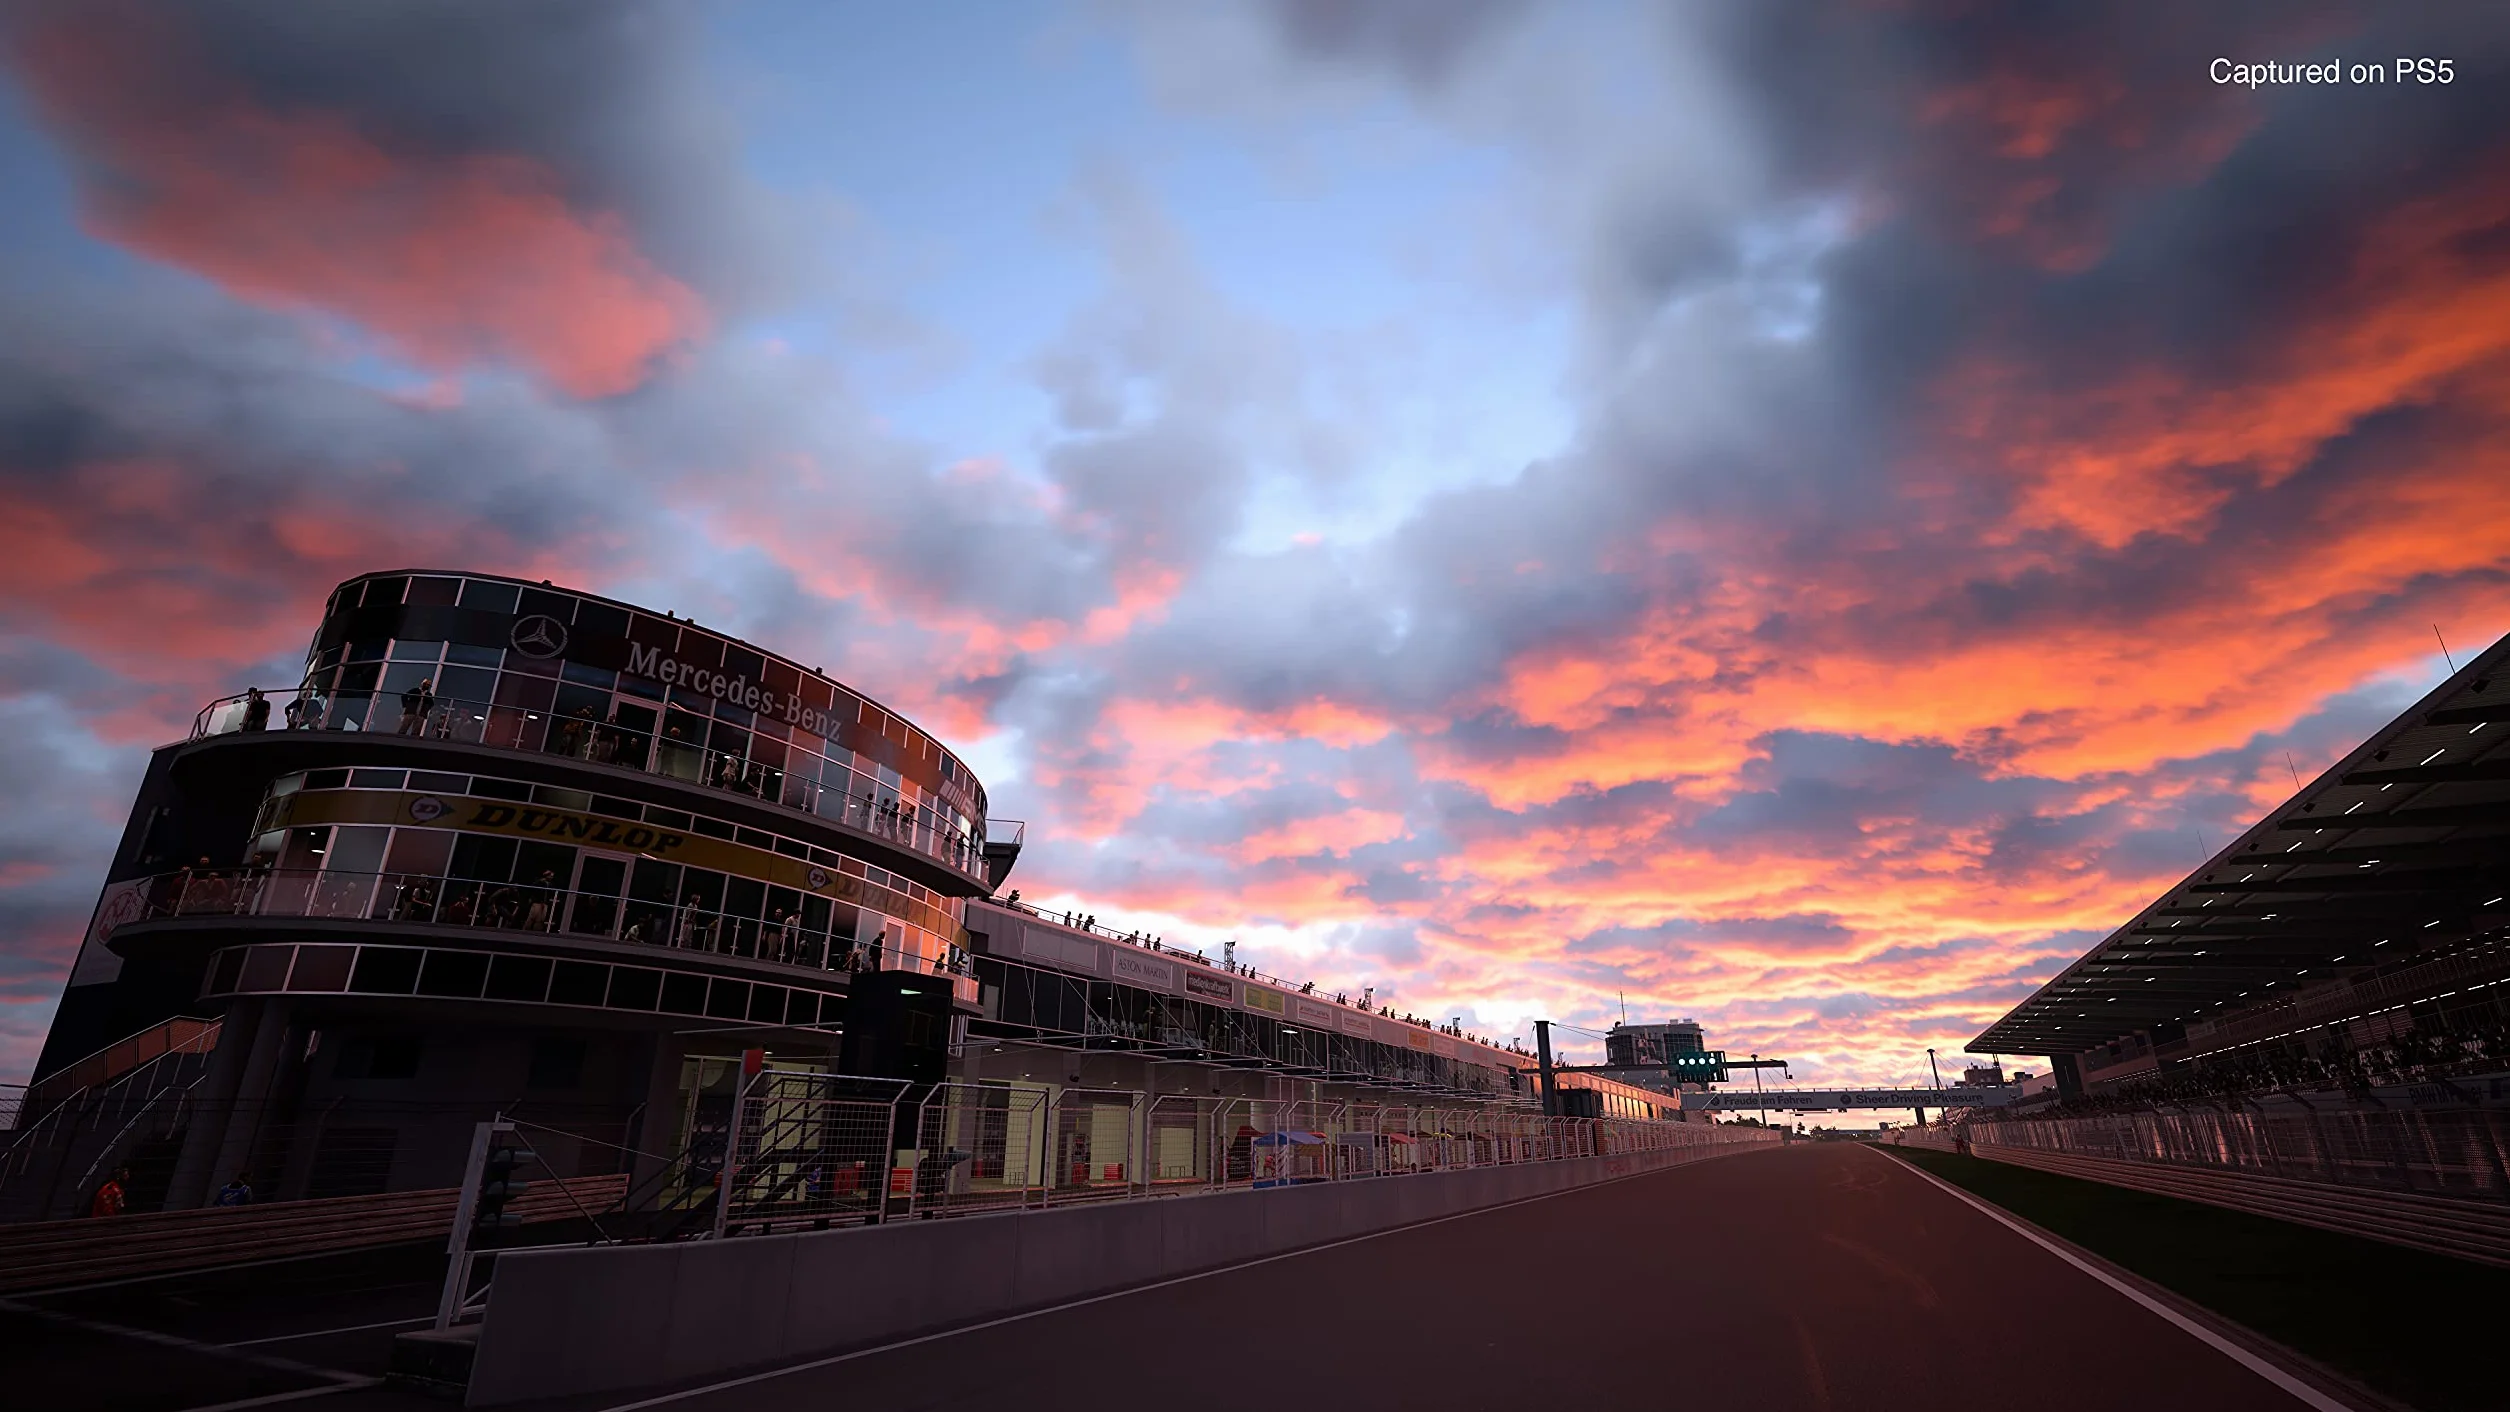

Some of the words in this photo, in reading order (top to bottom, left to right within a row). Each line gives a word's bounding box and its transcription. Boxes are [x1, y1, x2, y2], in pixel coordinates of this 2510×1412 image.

[624, 641, 842, 741] Mercedes-Benz
[467, 803, 684, 853] DUNLOP
[1118, 958, 1141, 973] ASTON
[1143, 964, 1168, 980] MARTIN
[1760, 1097, 1776, 1105] am
[1856, 1094, 1889, 1105] Sheer
[1890, 1094, 1932, 1105] Driving
[1933, 1093, 1984, 1103] Pleasure
